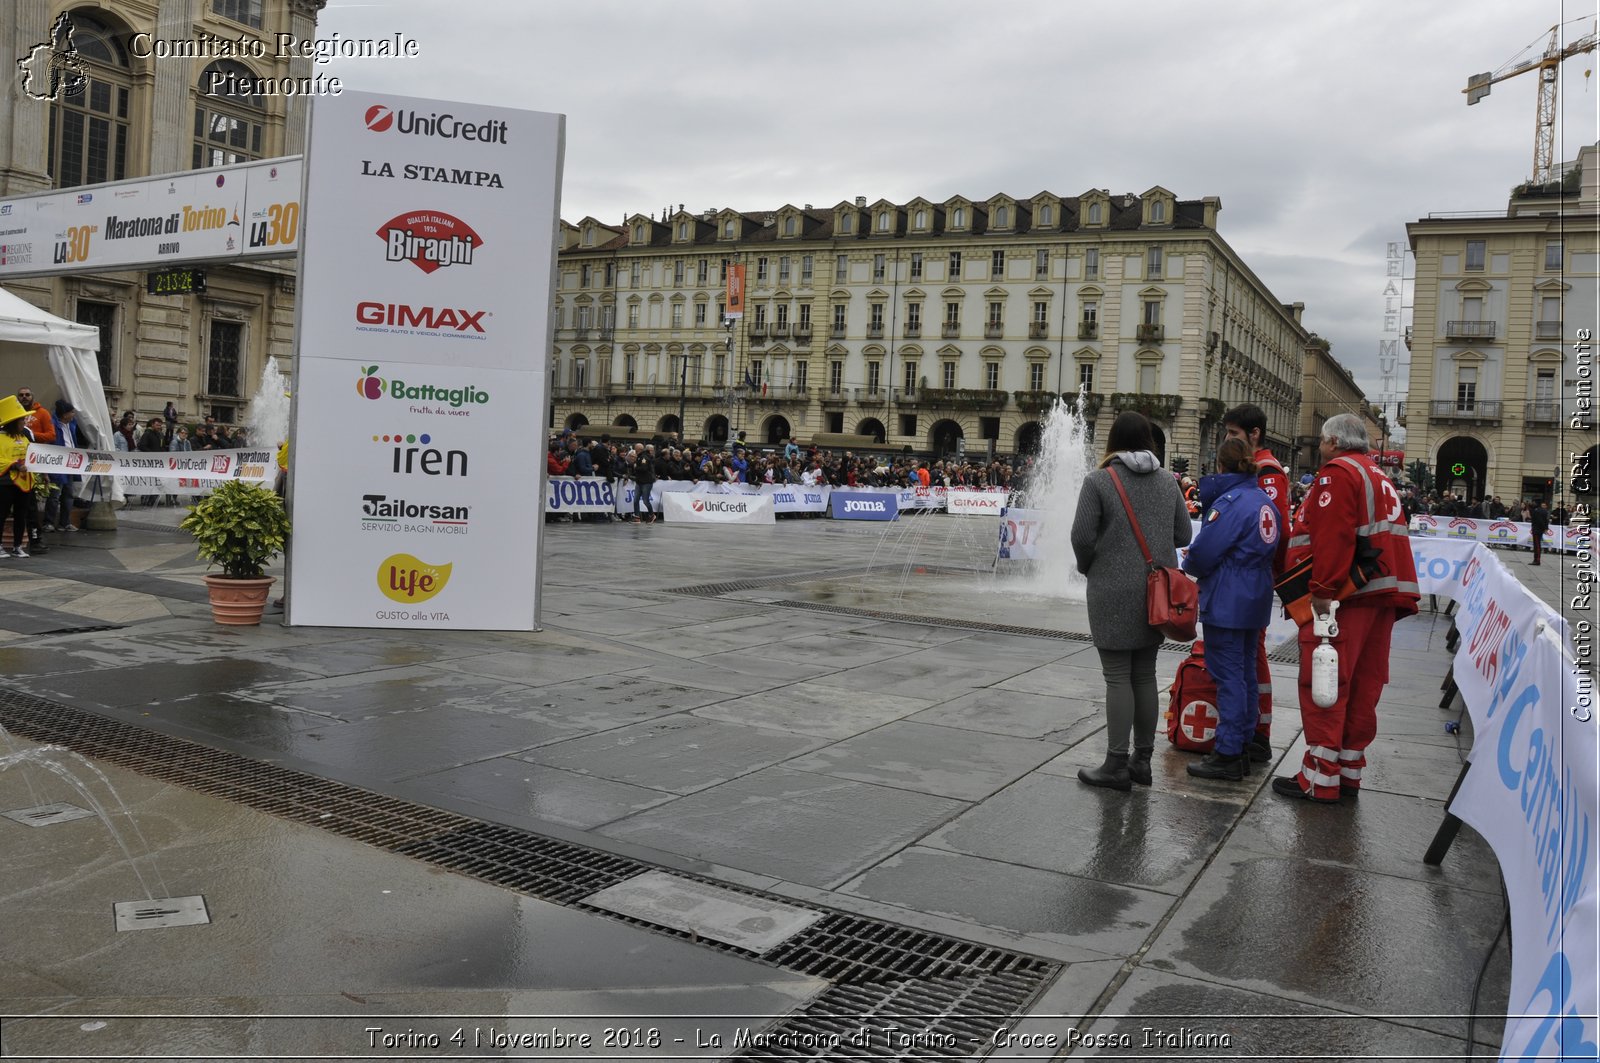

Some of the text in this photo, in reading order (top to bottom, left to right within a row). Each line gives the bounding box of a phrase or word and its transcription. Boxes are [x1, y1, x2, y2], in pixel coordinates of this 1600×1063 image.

[397, 109, 508, 145] UniCredit
[361, 160, 504, 189] LA STAMPA
[105, 205, 227, 240] Maratona di Torino
[431, 216, 455, 229] ITALIANA
[7, 243, 33, 255] REGIONE
[158, 242, 180, 255] ARRIVO
[386, 228, 473, 267] Biraghi
[6, 254, 33, 265] PIEMONTE
[356, 301, 487, 333] GIMAX
[442, 333, 487, 341] COMMERCIALI
[391, 380, 489, 408] Battaglio
[435, 407, 446, 415] da
[448, 408, 470, 417] vivere
[36, 453, 64, 466] UniCredit
[120, 455, 228, 472] LA STAMPA UniCredit RDS
[236, 452, 271, 466] Maratona
[393, 440, 468, 477] iren
[362, 494, 469, 520] Tailorsan
[704, 501, 748, 513] UniCredit
[953, 499, 998, 508] GIMAX
[361, 522, 468, 535] SERVIZIO BAGNI MOBILI
[390, 565, 437, 597] life
[375, 611, 450, 621] GUSTO alla VITA
